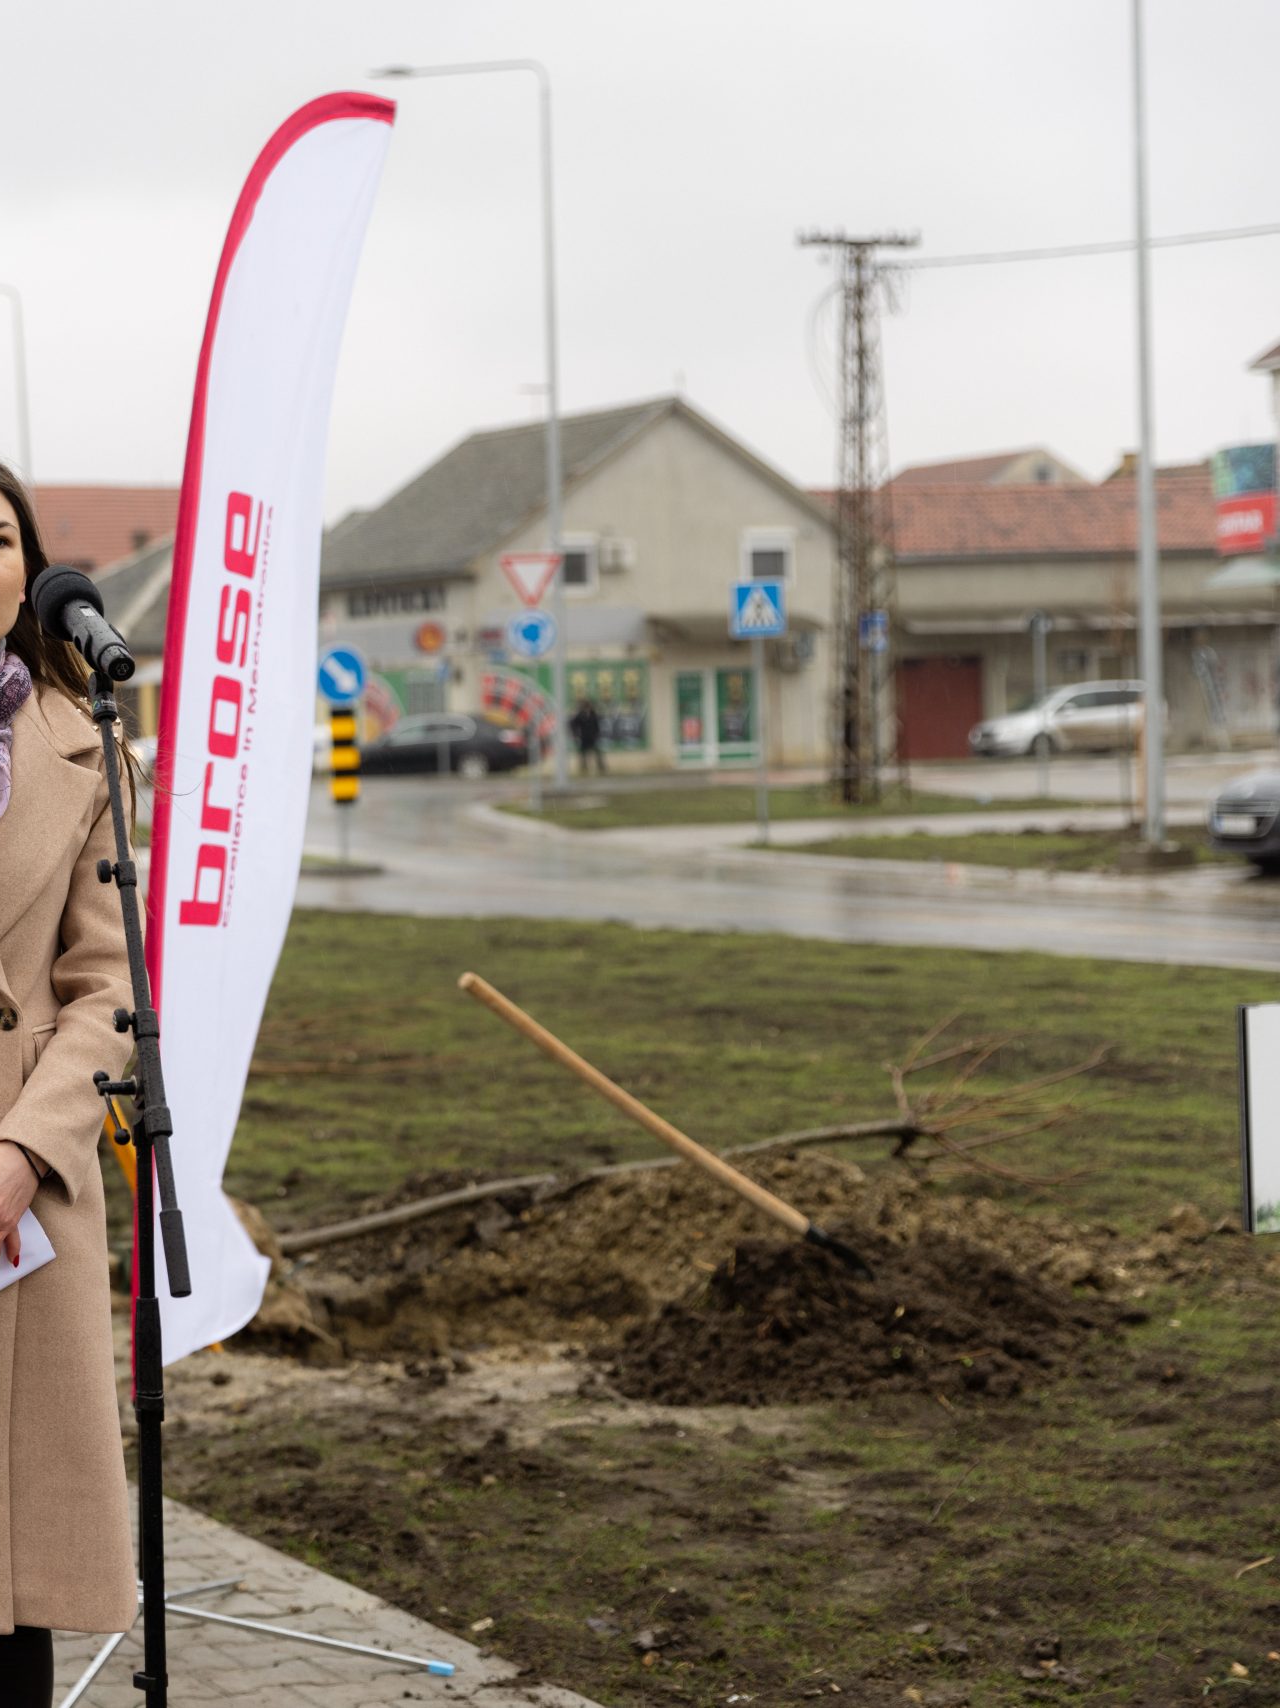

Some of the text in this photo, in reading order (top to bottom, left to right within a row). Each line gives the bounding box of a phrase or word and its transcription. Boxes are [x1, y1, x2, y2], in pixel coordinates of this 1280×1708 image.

[179, 491, 263, 927] brose
[222, 505, 274, 928] Excellence in Mechatronics
